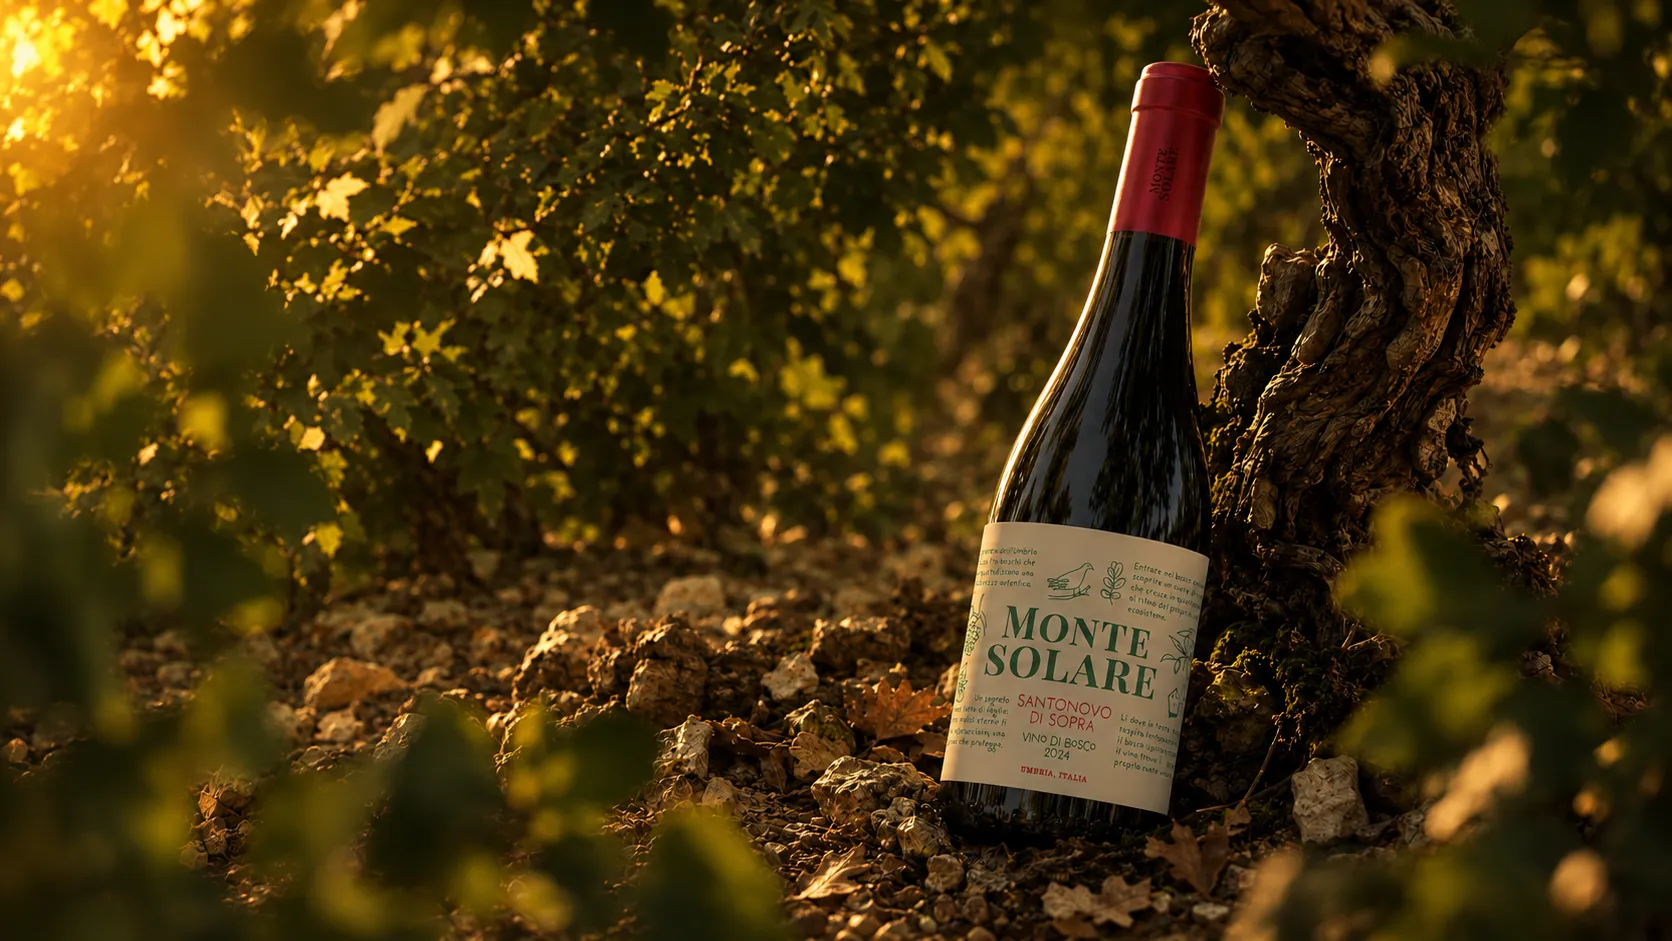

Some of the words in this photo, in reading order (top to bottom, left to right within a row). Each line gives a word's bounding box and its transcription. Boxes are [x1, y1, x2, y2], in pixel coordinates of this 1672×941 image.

[1149, 148, 1167, 194] MONTE
[1159, 147, 1179, 201] SOLARE
[1134, 562, 1162, 575] Entrare
[1133, 574, 1162, 584] scoprire
[1131, 584, 1144, 593] che
[1002, 605, 1151, 659] MONTE
[984, 644, 1158, 700] SOLARE
[1017, 693, 1112, 719] SANTONOVO
[1029, 710, 1043, 724] DI
[1048, 713, 1094, 732] SOPRA
[1049, 735, 1061, 747] DI
[1117, 735, 1123, 744] il
[1043, 747, 1070, 761] 2024
[1115, 747, 1121, 755] il
[1122, 750, 1138, 759] vino
[1113, 759, 1141, 771] proprio
[1020, 765, 1056, 778] UMBRIA,
[1058, 771, 1087, 783] ITALIA
